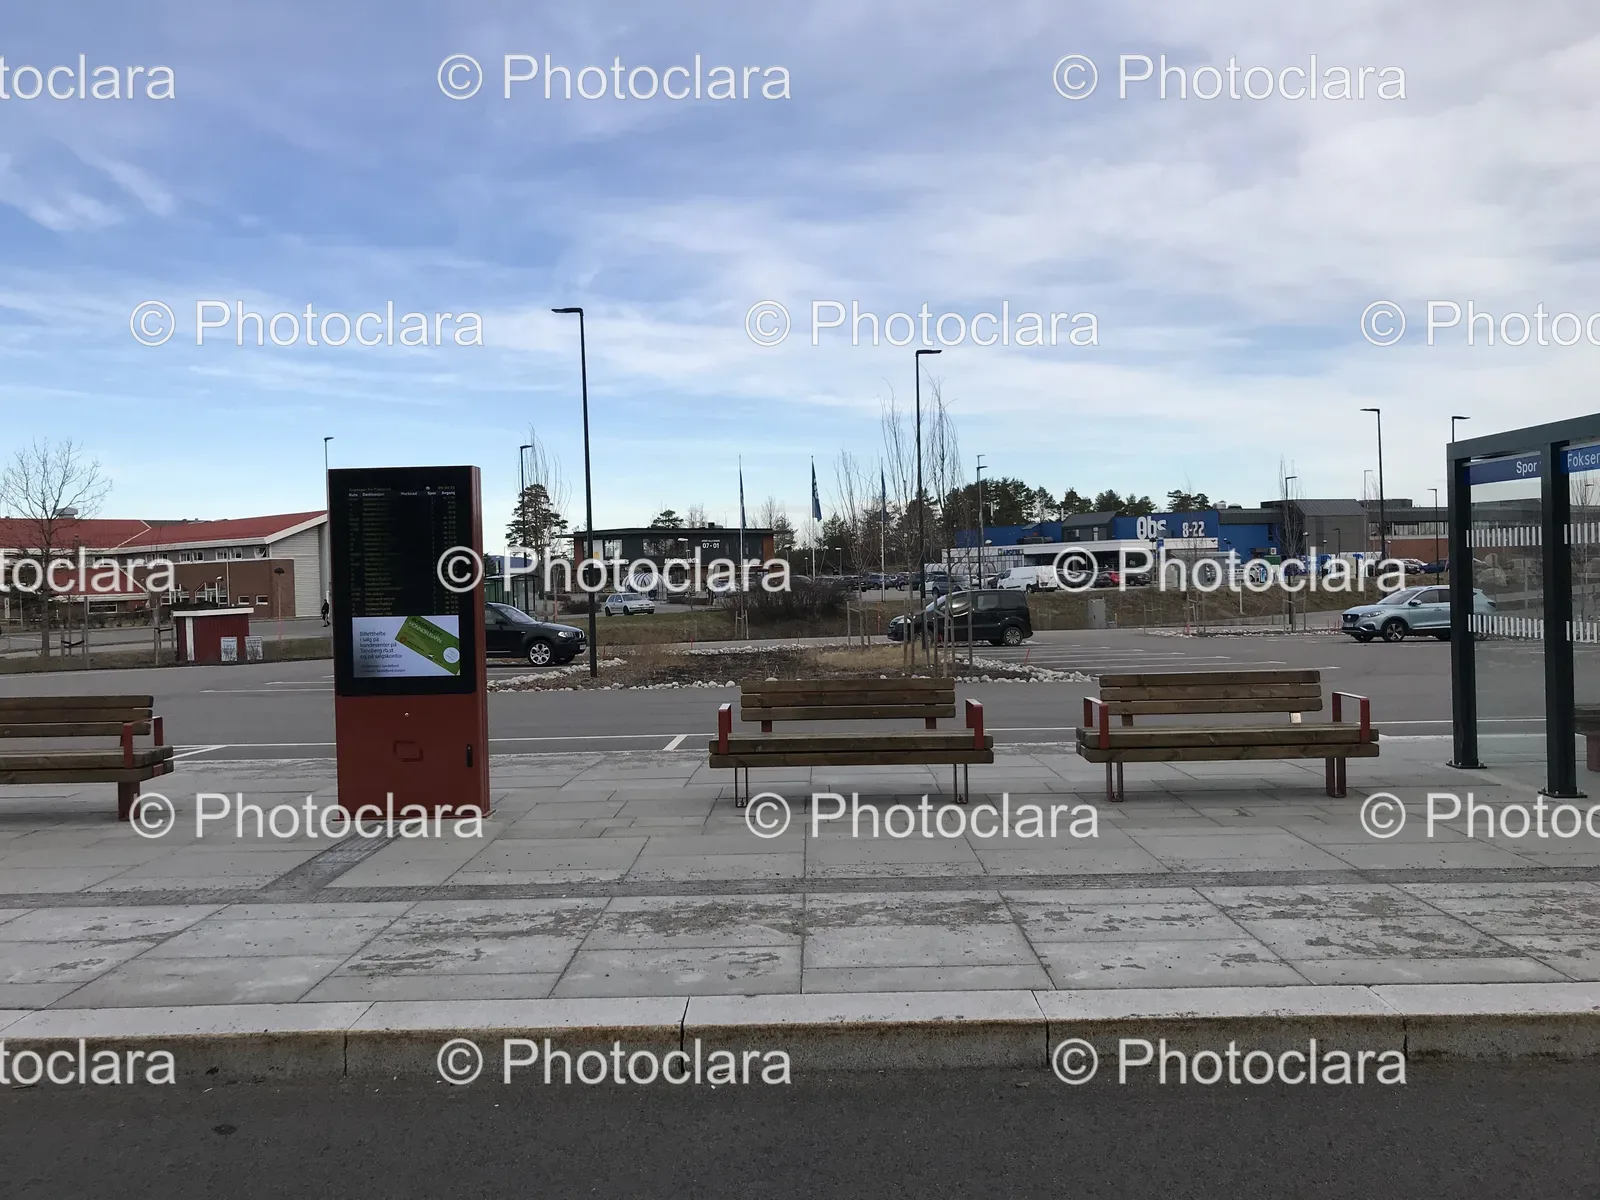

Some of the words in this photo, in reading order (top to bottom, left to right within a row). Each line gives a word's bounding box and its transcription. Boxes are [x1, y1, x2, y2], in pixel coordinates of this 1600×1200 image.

[1516, 460, 1538, 476] Spor
[1136, 516, 1167, 540] Obs
[1182, 521, 1205, 538] 8-22
